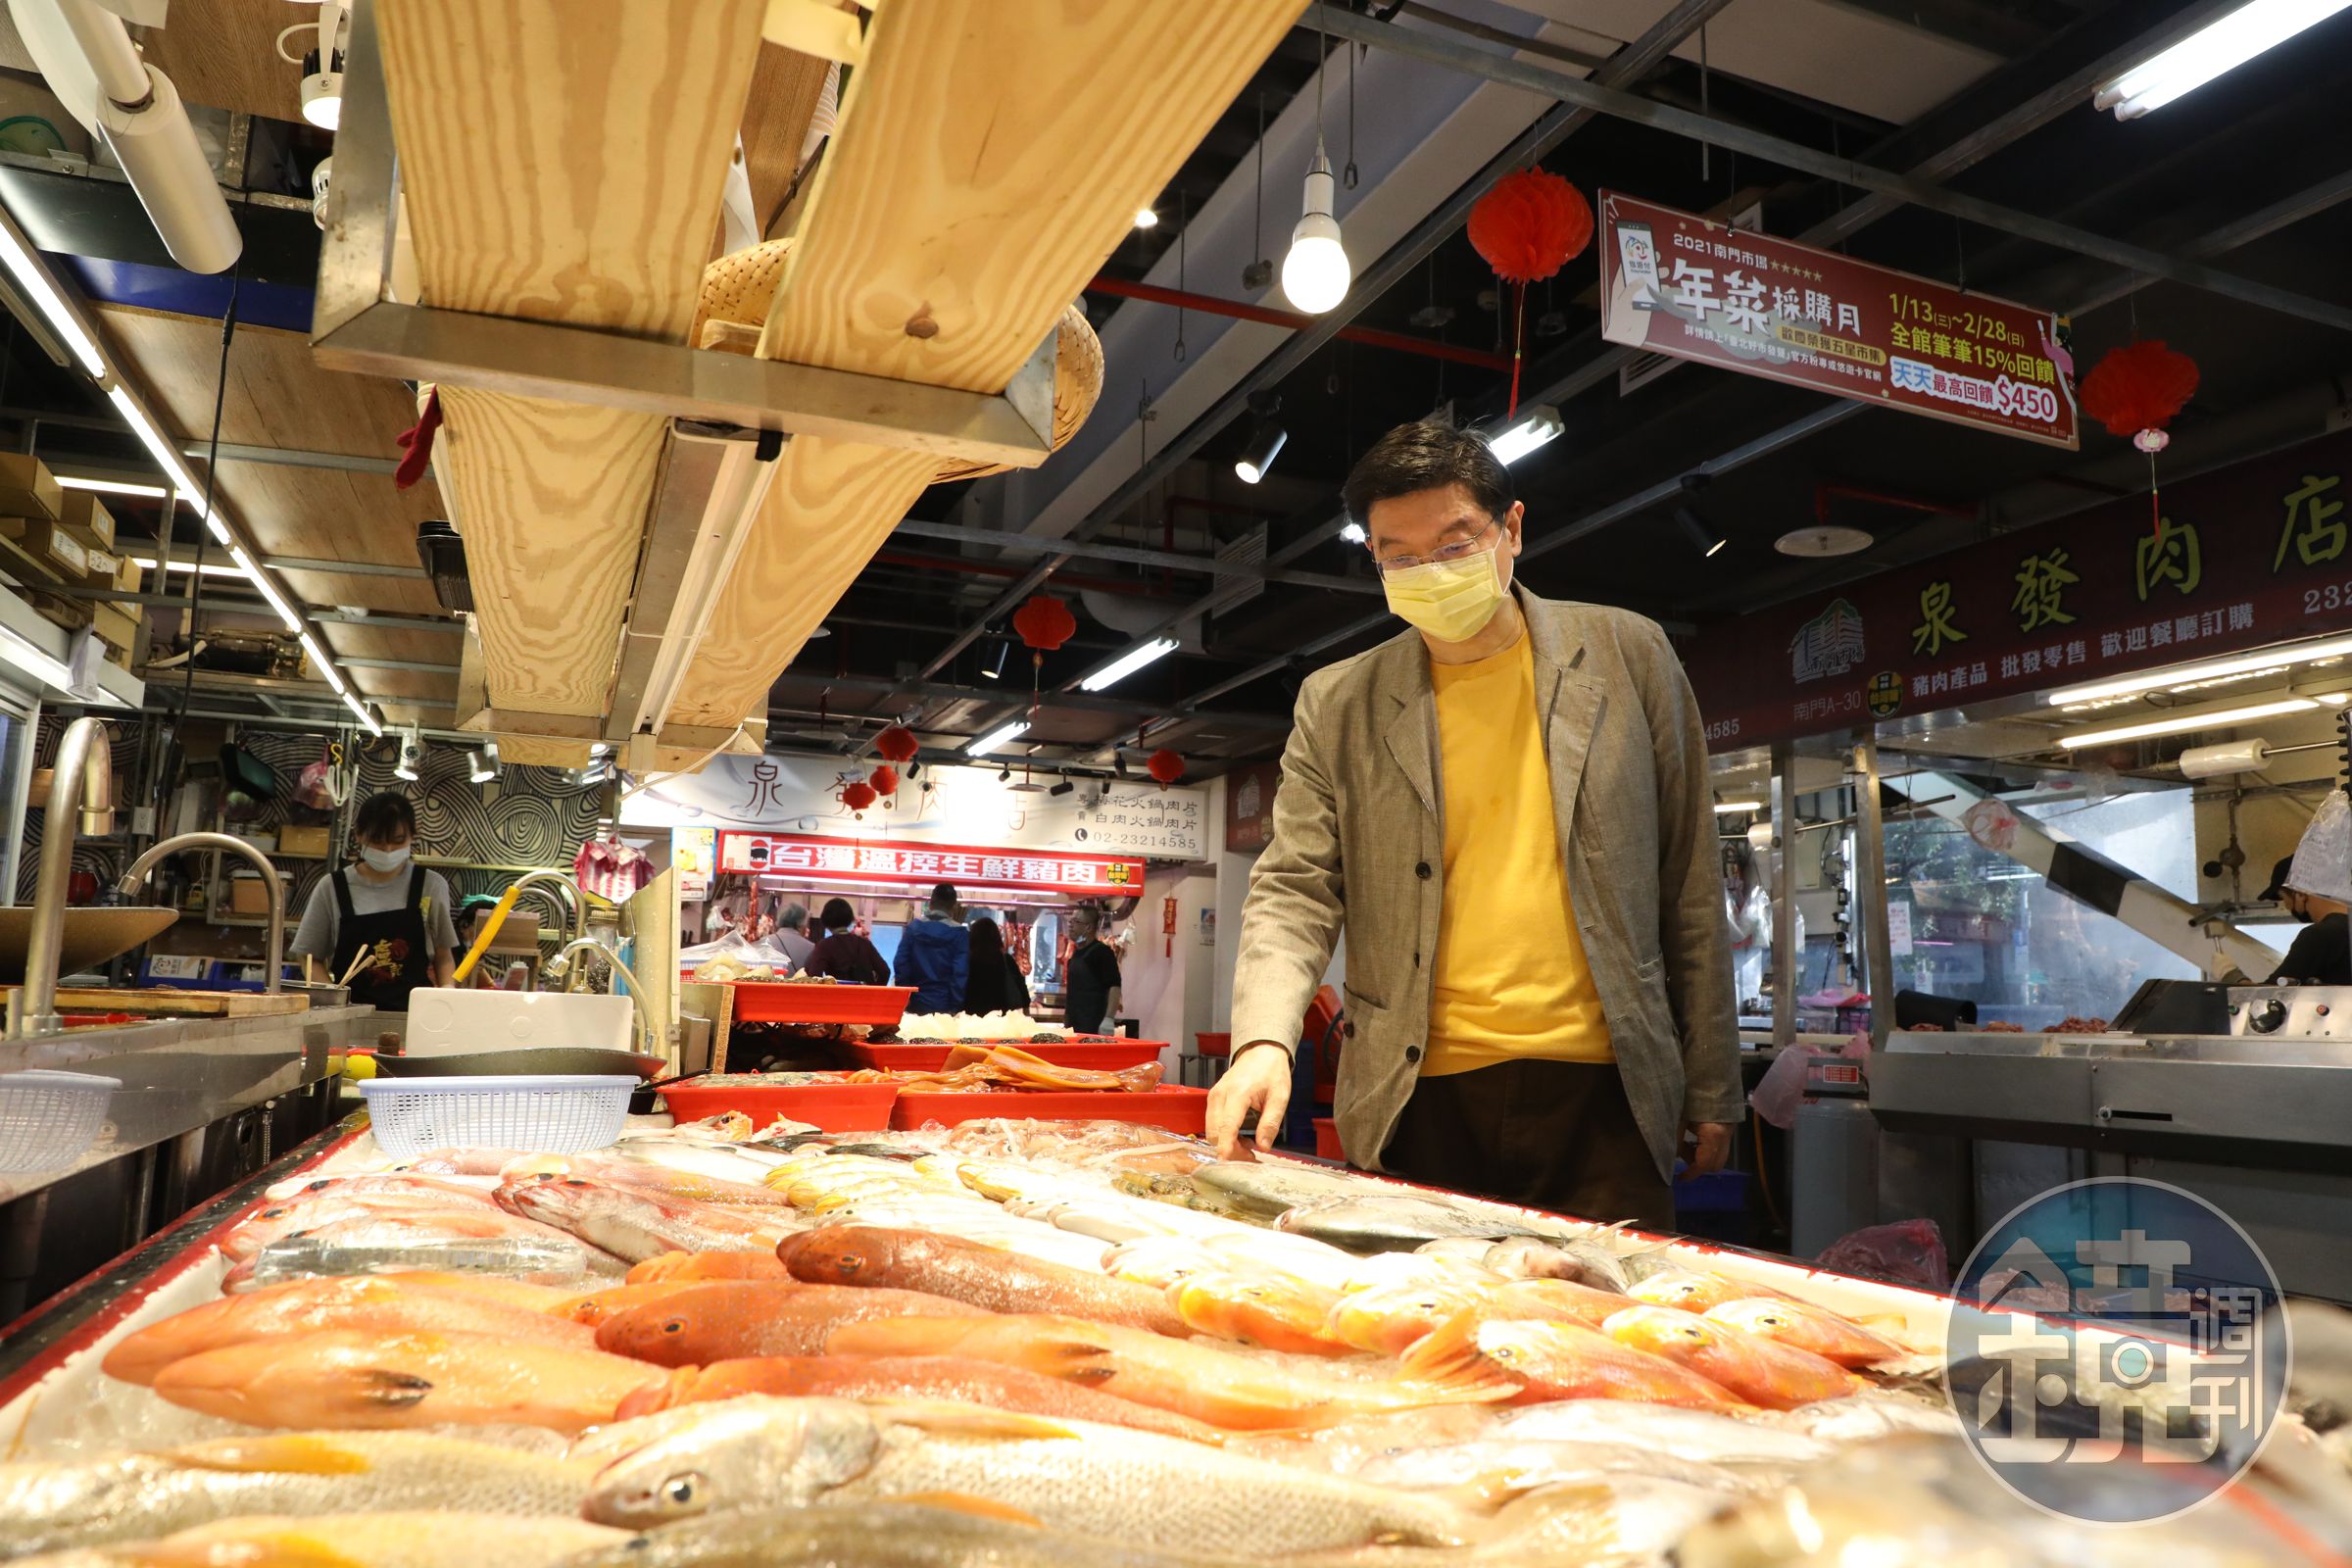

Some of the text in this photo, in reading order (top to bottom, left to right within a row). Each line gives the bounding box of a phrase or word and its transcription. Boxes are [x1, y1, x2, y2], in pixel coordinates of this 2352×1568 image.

[1673, 232, 1769, 270] 2021南門市場
[1672, 258, 1861, 337] 年菜採購月
[1890, 321, 2055, 385] 全館筆筆15%回饋
[1912, 474, 2348, 656] 泉發肉店
[1912, 603, 2254, 696] 豬肉產品 批發零售 歡迎餐廳訂購
[1793, 690, 1861, 722] 南門A-30
[1705, 718, 1740, 741] 4585
[1095, 812, 1198, 831] 白肉火鍋肉片
[1094, 832, 1197, 849] 02-23214585
[773, 846, 1097, 882] 台灣溫控生鮮豬肉
